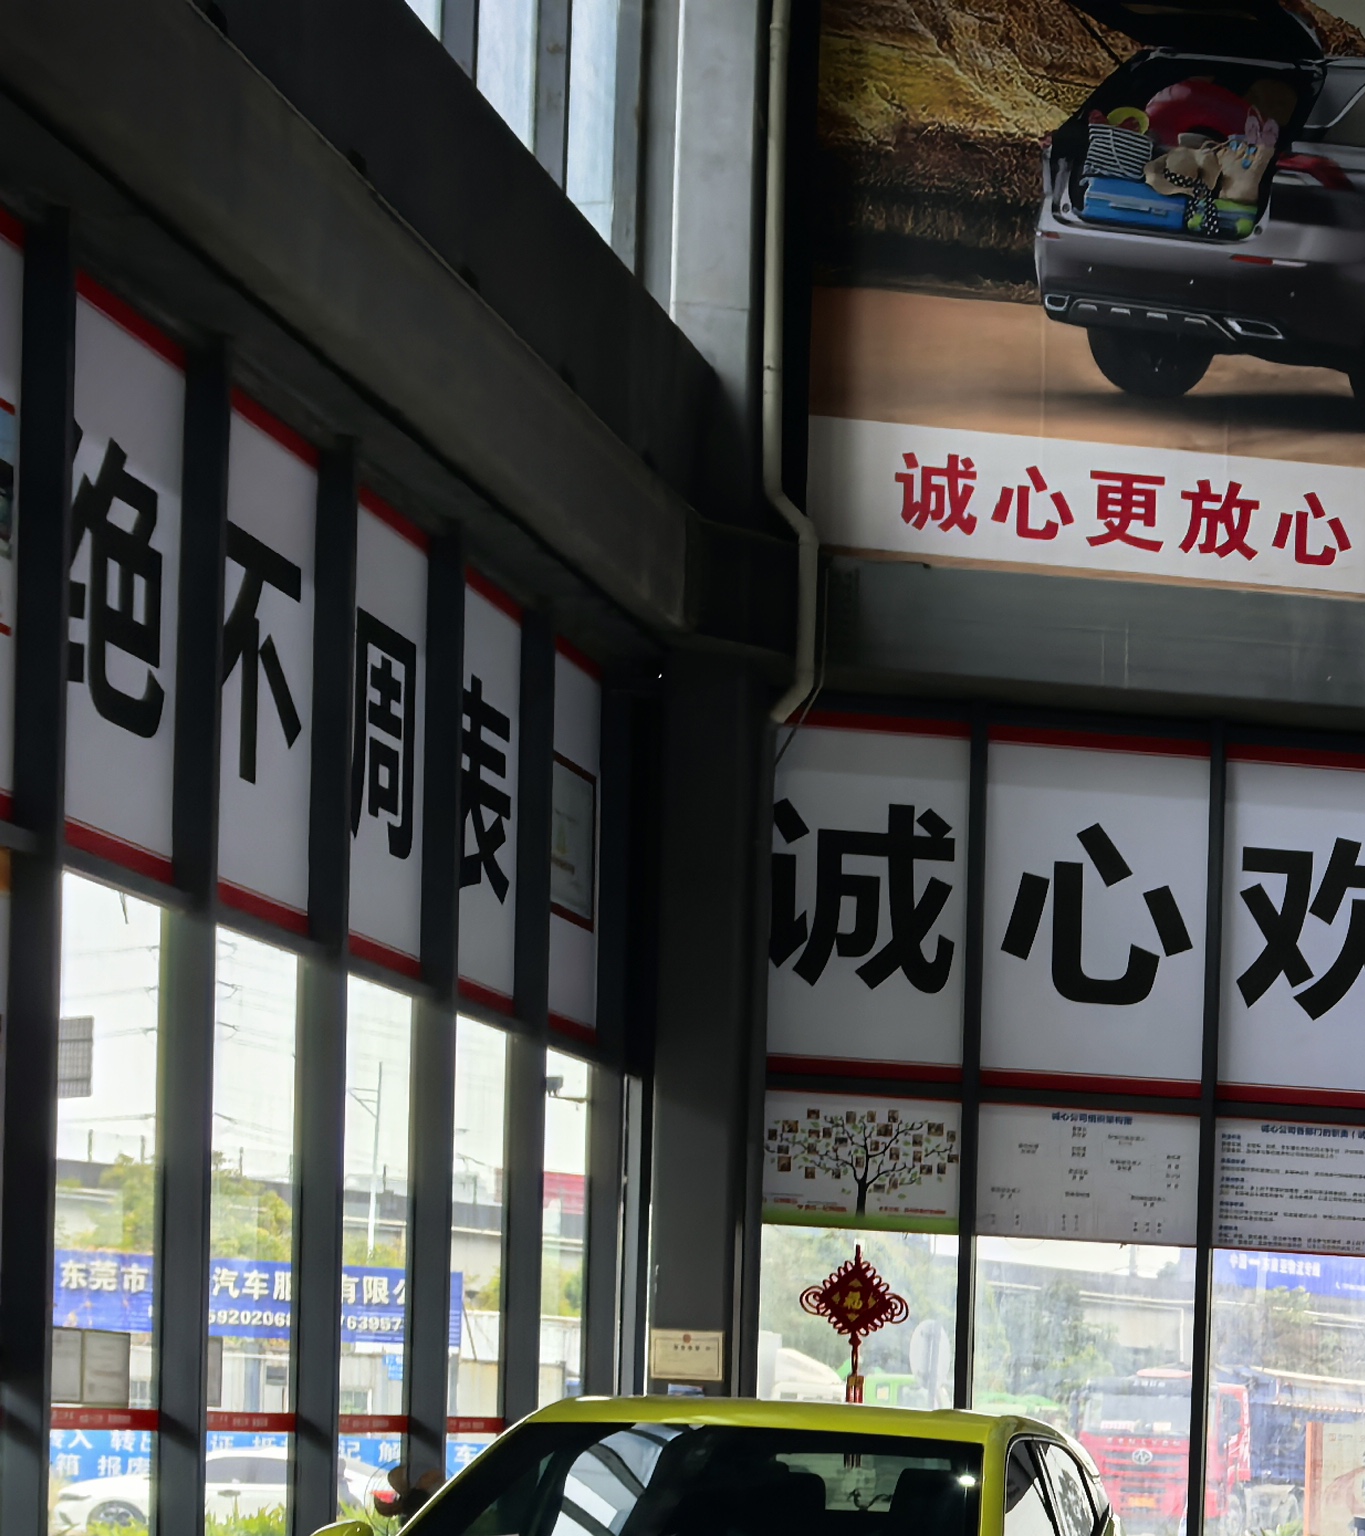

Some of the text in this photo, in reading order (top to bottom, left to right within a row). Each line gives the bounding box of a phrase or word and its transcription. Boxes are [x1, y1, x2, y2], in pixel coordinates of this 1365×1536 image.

[894, 452, 1352, 567] 诚心更放心
